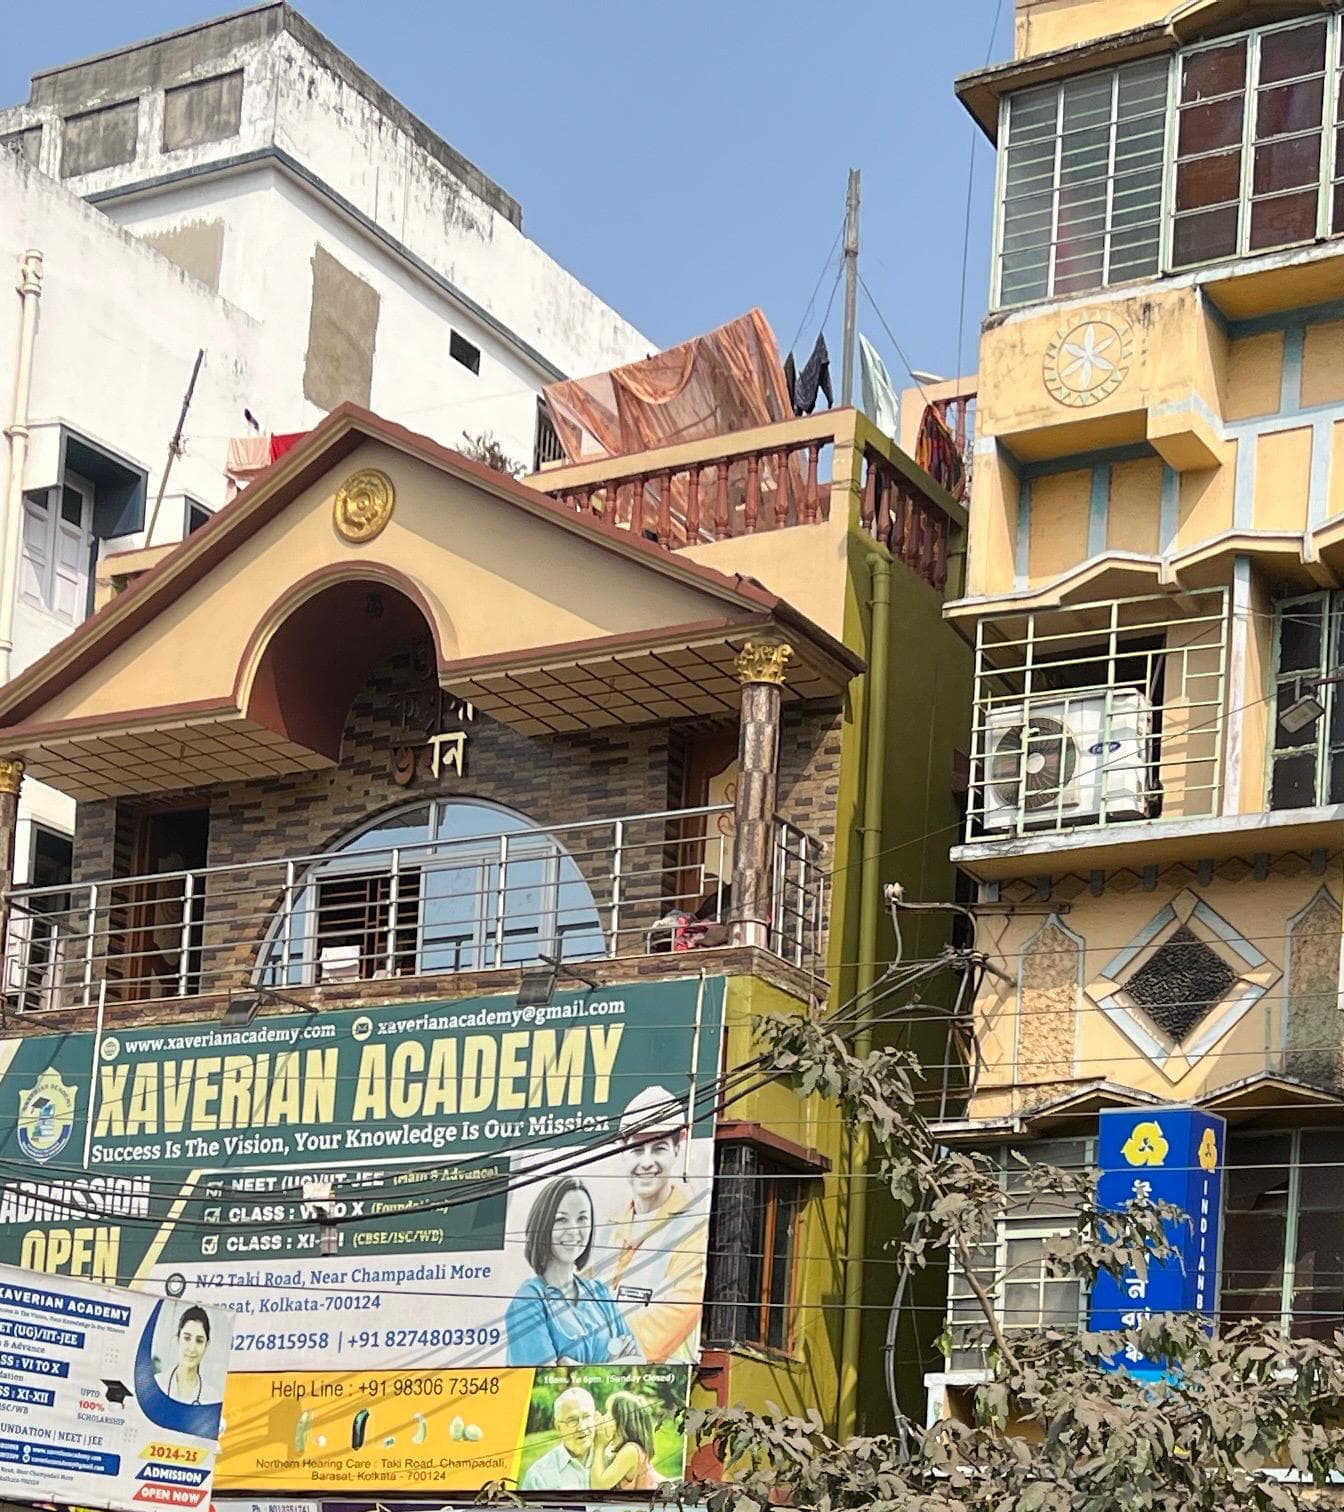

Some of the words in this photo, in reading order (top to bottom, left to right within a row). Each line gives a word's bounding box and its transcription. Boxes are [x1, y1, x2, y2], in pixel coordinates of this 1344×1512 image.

[125, 1023, 336, 1053] www.xaverianacademy.com
[377, 1000, 626, 1036] xaverianacademy@gmail.com
[94, 1048, 339, 1138] XAVERIAN
[352, 1022, 625, 1121] ACADEMY
[92, 1139, 162, 1163] Success
[165, 1140, 181, 1159] Is
[185, 1138, 220, 1157] The
[224, 1136, 290, 1156] Vision,
[294, 1132, 342, 1151] Your
[345, 1121, 457, 1148] Knowledge
[461, 1119, 480, 1138] Is
[484, 1118, 524, 1138] Our
[528, 1114, 610, 1136] Mission
[232, 1178, 277, 1192] NEET
[228, 1205, 286, 1222] CLASS
[227, 1234, 282, 1252] CLASS
[19, 1226, 121, 1288] OPEN
[228, 1272, 261, 1288] Taki
[264, 1272, 307, 1287] Road,
[310, 1268, 348, 1285] Near
[351, 1264, 447, 1290] Champadali
[451, 1265, 492, 1279] More
[67, 1299, 130, 1321] ACADEMY
[258, 1295, 382, 1313] Kolkata-700124
[11, 1340, 46, 1354] Advance
[384, 1328, 500, 1348] 8274803309
[37, 1361, 51, 1372] TO
[16, 1389, 49, 1404] XI-XII
[271, 1380, 307, 1399] Help
[311, 1380, 344, 1398] Line
[358, 1382, 388, 1397] +91
[393, 1378, 444, 1397] 98306
[449, 1378, 500, 1396] 73548
[78, 1400, 105, 1412] 100%
[58, 1431, 83, 1445] NEET
[87, 1434, 103, 1447] JEE
[149, 1445, 198, 1462] 2024-25
[346, 1458, 372, 1469] Care
[381, 1458, 404, 1469] Taki
[143, 1465, 202, 1484] ADMISSION
[357, 1469, 397, 1481] Kolkata
[407, 1469, 447, 1481] 700124
[140, 1487, 170, 1501] OPEN
[173, 1490, 201, 1505] NOW
